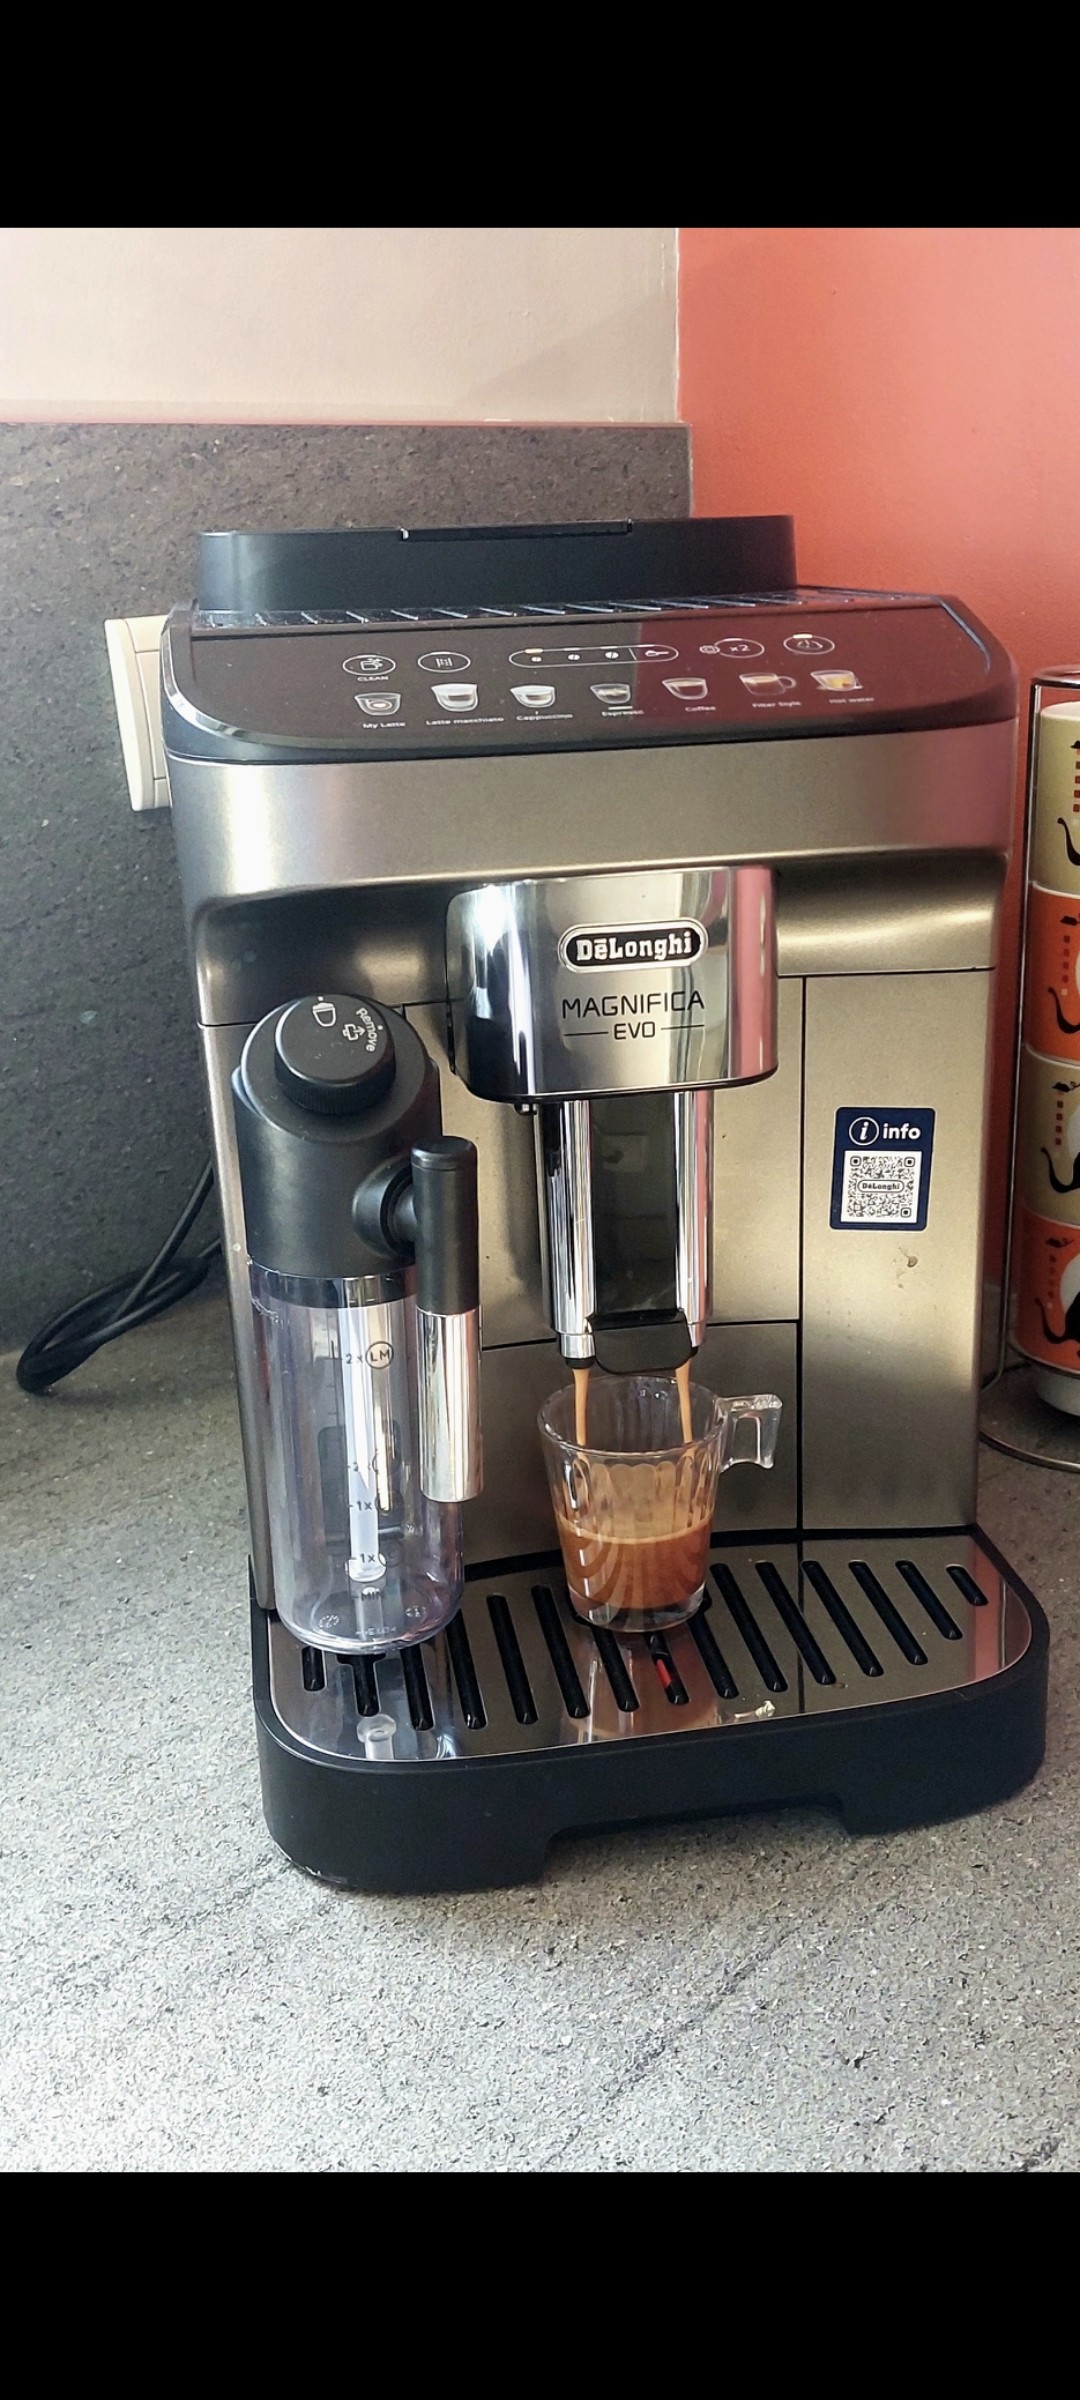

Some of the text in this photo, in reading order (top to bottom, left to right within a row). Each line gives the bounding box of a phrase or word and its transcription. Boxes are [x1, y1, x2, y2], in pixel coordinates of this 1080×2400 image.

[562, 990, 705, 1019] MAGNIFICA
[356, 1008, 377, 1052] Remove
[613, 1021, 656, 1040] EVO
[882, 1122, 921, 1140] info
[370, 1349, 390, 1362] LM
